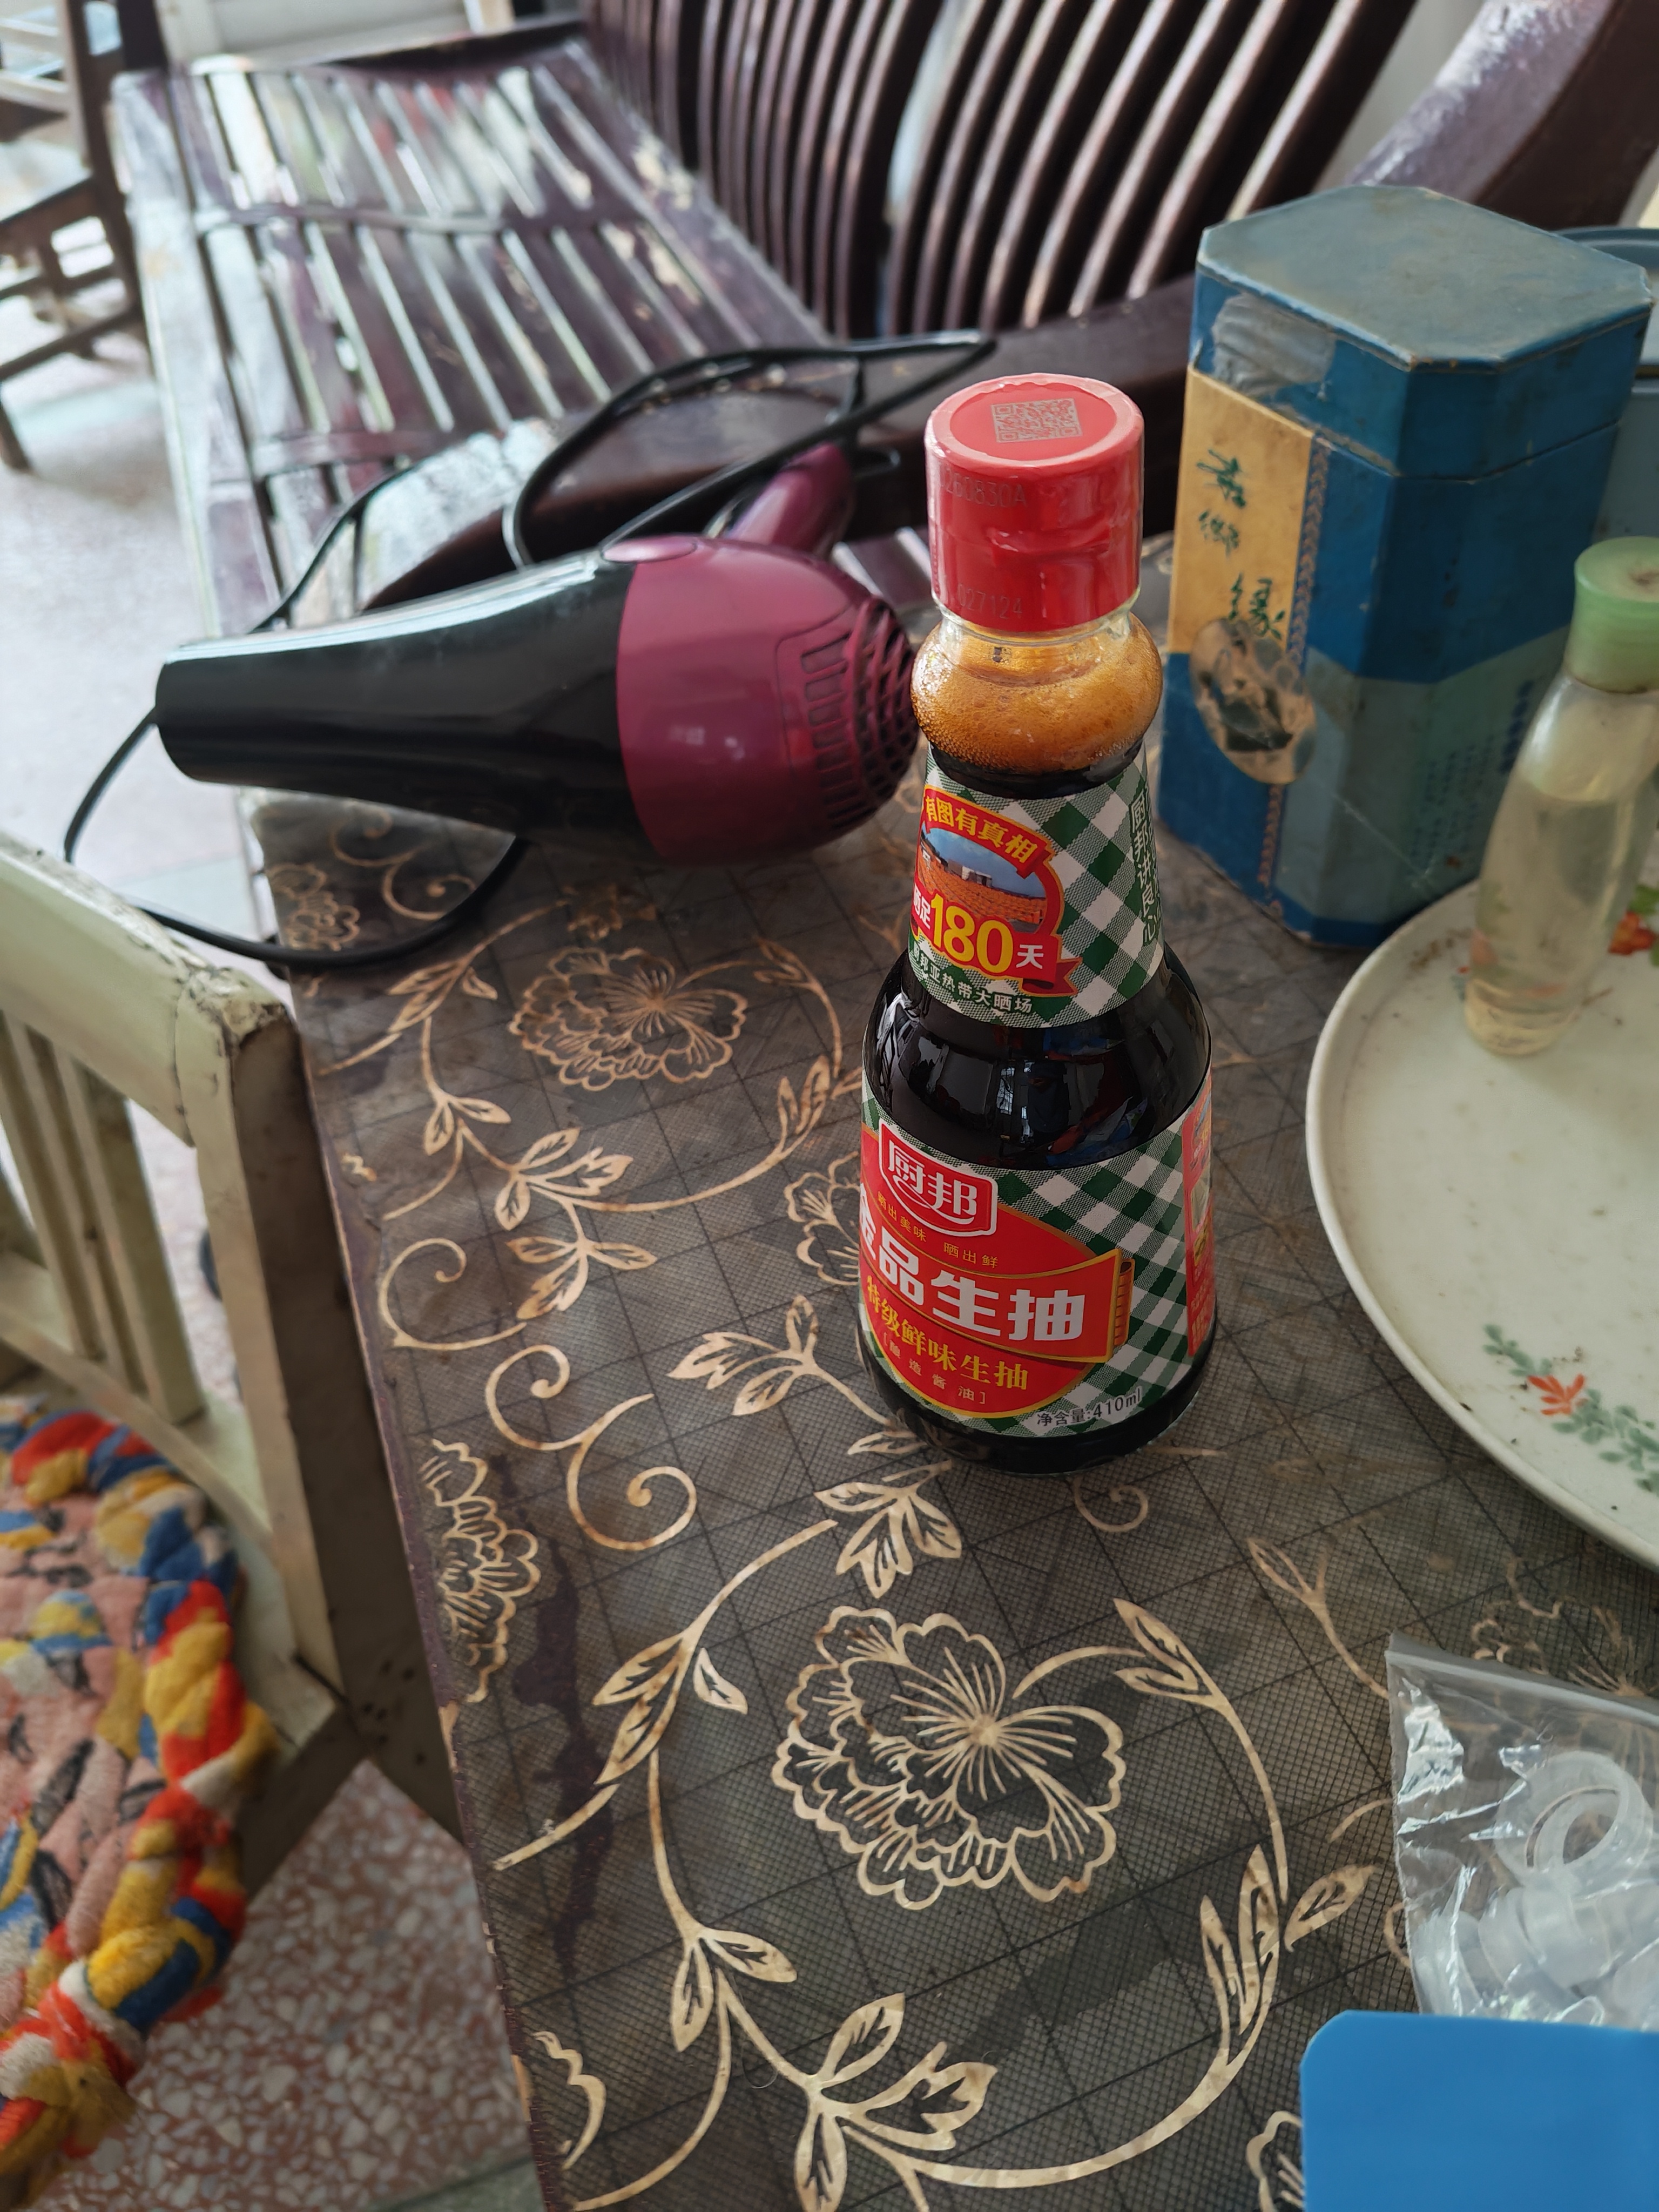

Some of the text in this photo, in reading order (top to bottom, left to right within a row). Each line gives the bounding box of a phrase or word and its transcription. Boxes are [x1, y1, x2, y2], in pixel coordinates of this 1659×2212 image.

[925, 796, 1038, 864] 有图有真相
[1130, 790, 1156, 942] 厨邦讲良心
[913, 941, 1033, 1014] 厨邦亚热带大晒场
[888, 1139, 977, 1217] 厨邦
[867, 1275, 1028, 1390] 特级鲜味生抽
